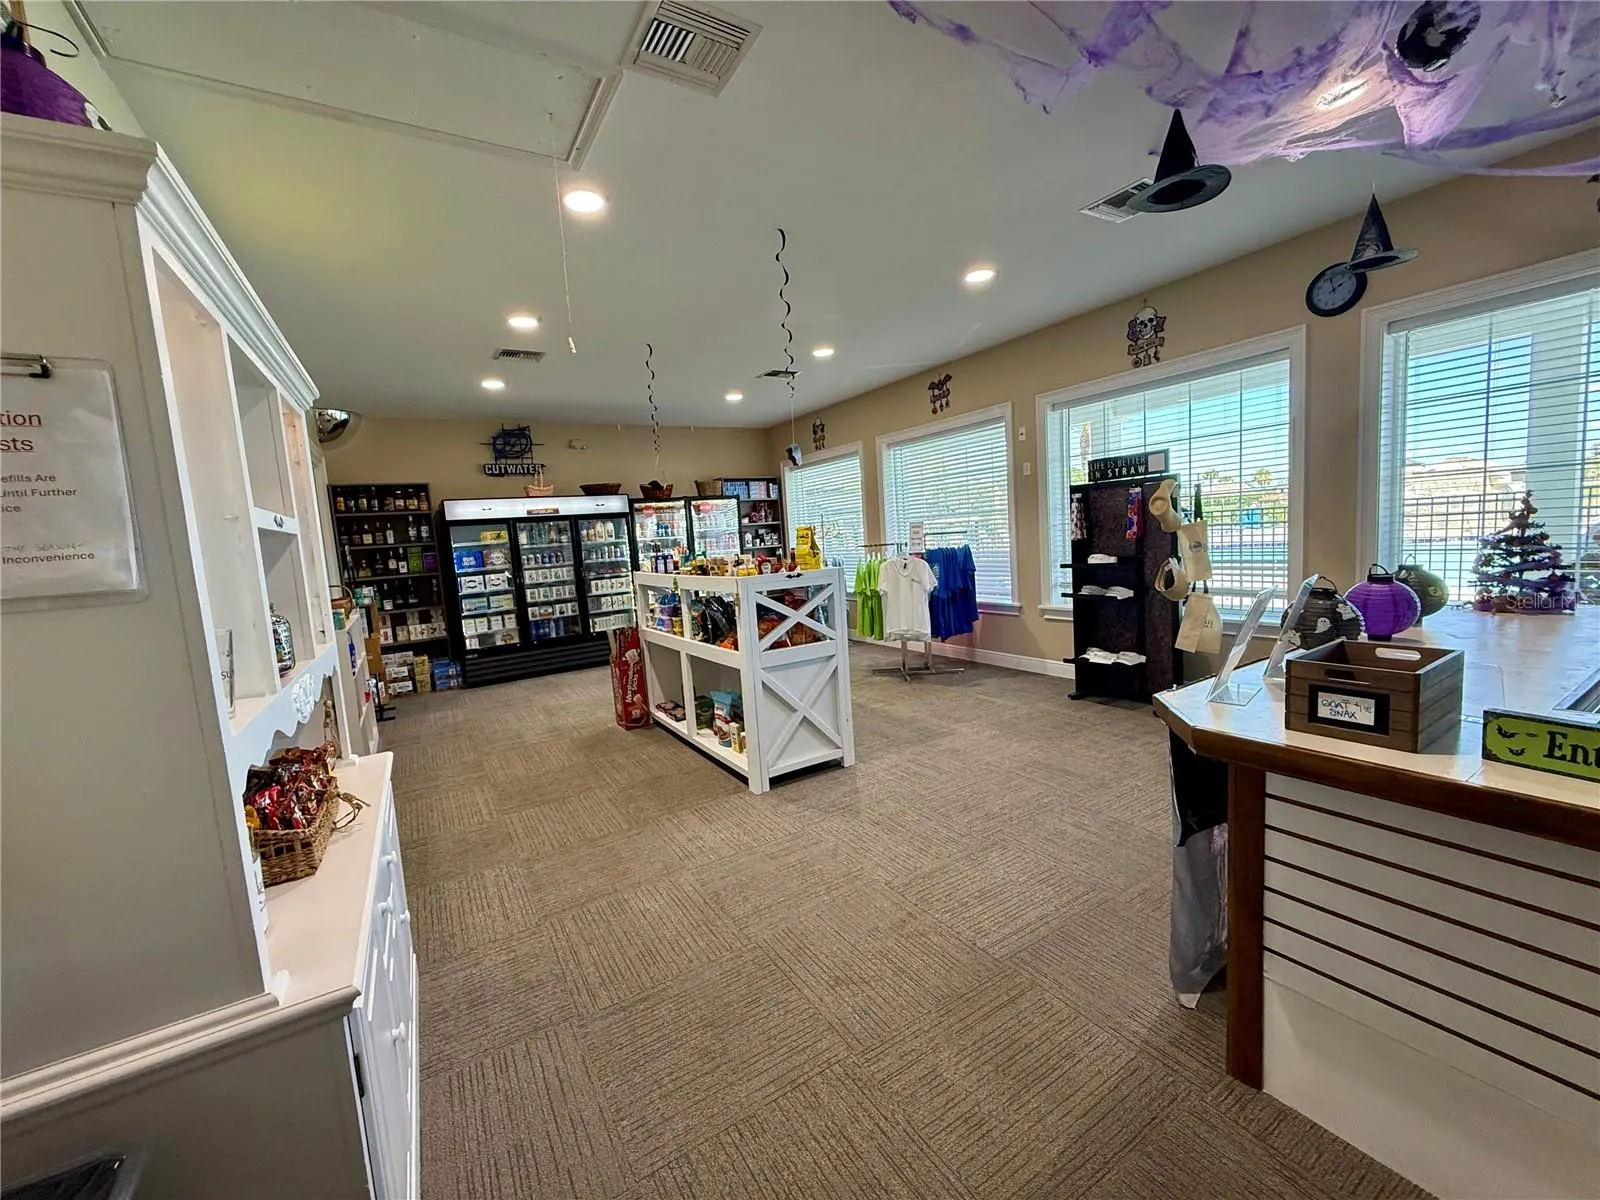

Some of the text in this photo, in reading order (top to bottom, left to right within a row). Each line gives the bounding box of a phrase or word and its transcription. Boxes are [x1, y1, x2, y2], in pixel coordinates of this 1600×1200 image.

[1089, 462, 1105, 471] LIFE
[1107, 465, 1146, 478] STRAW
[35, 474, 57, 482] Are
[31, 488, 77, 497] Further
[2, 552, 95, 565] Inconvenience
[1321, 699, 1350, 709] GOAT
[1329, 707, 1358, 720] SNAX
